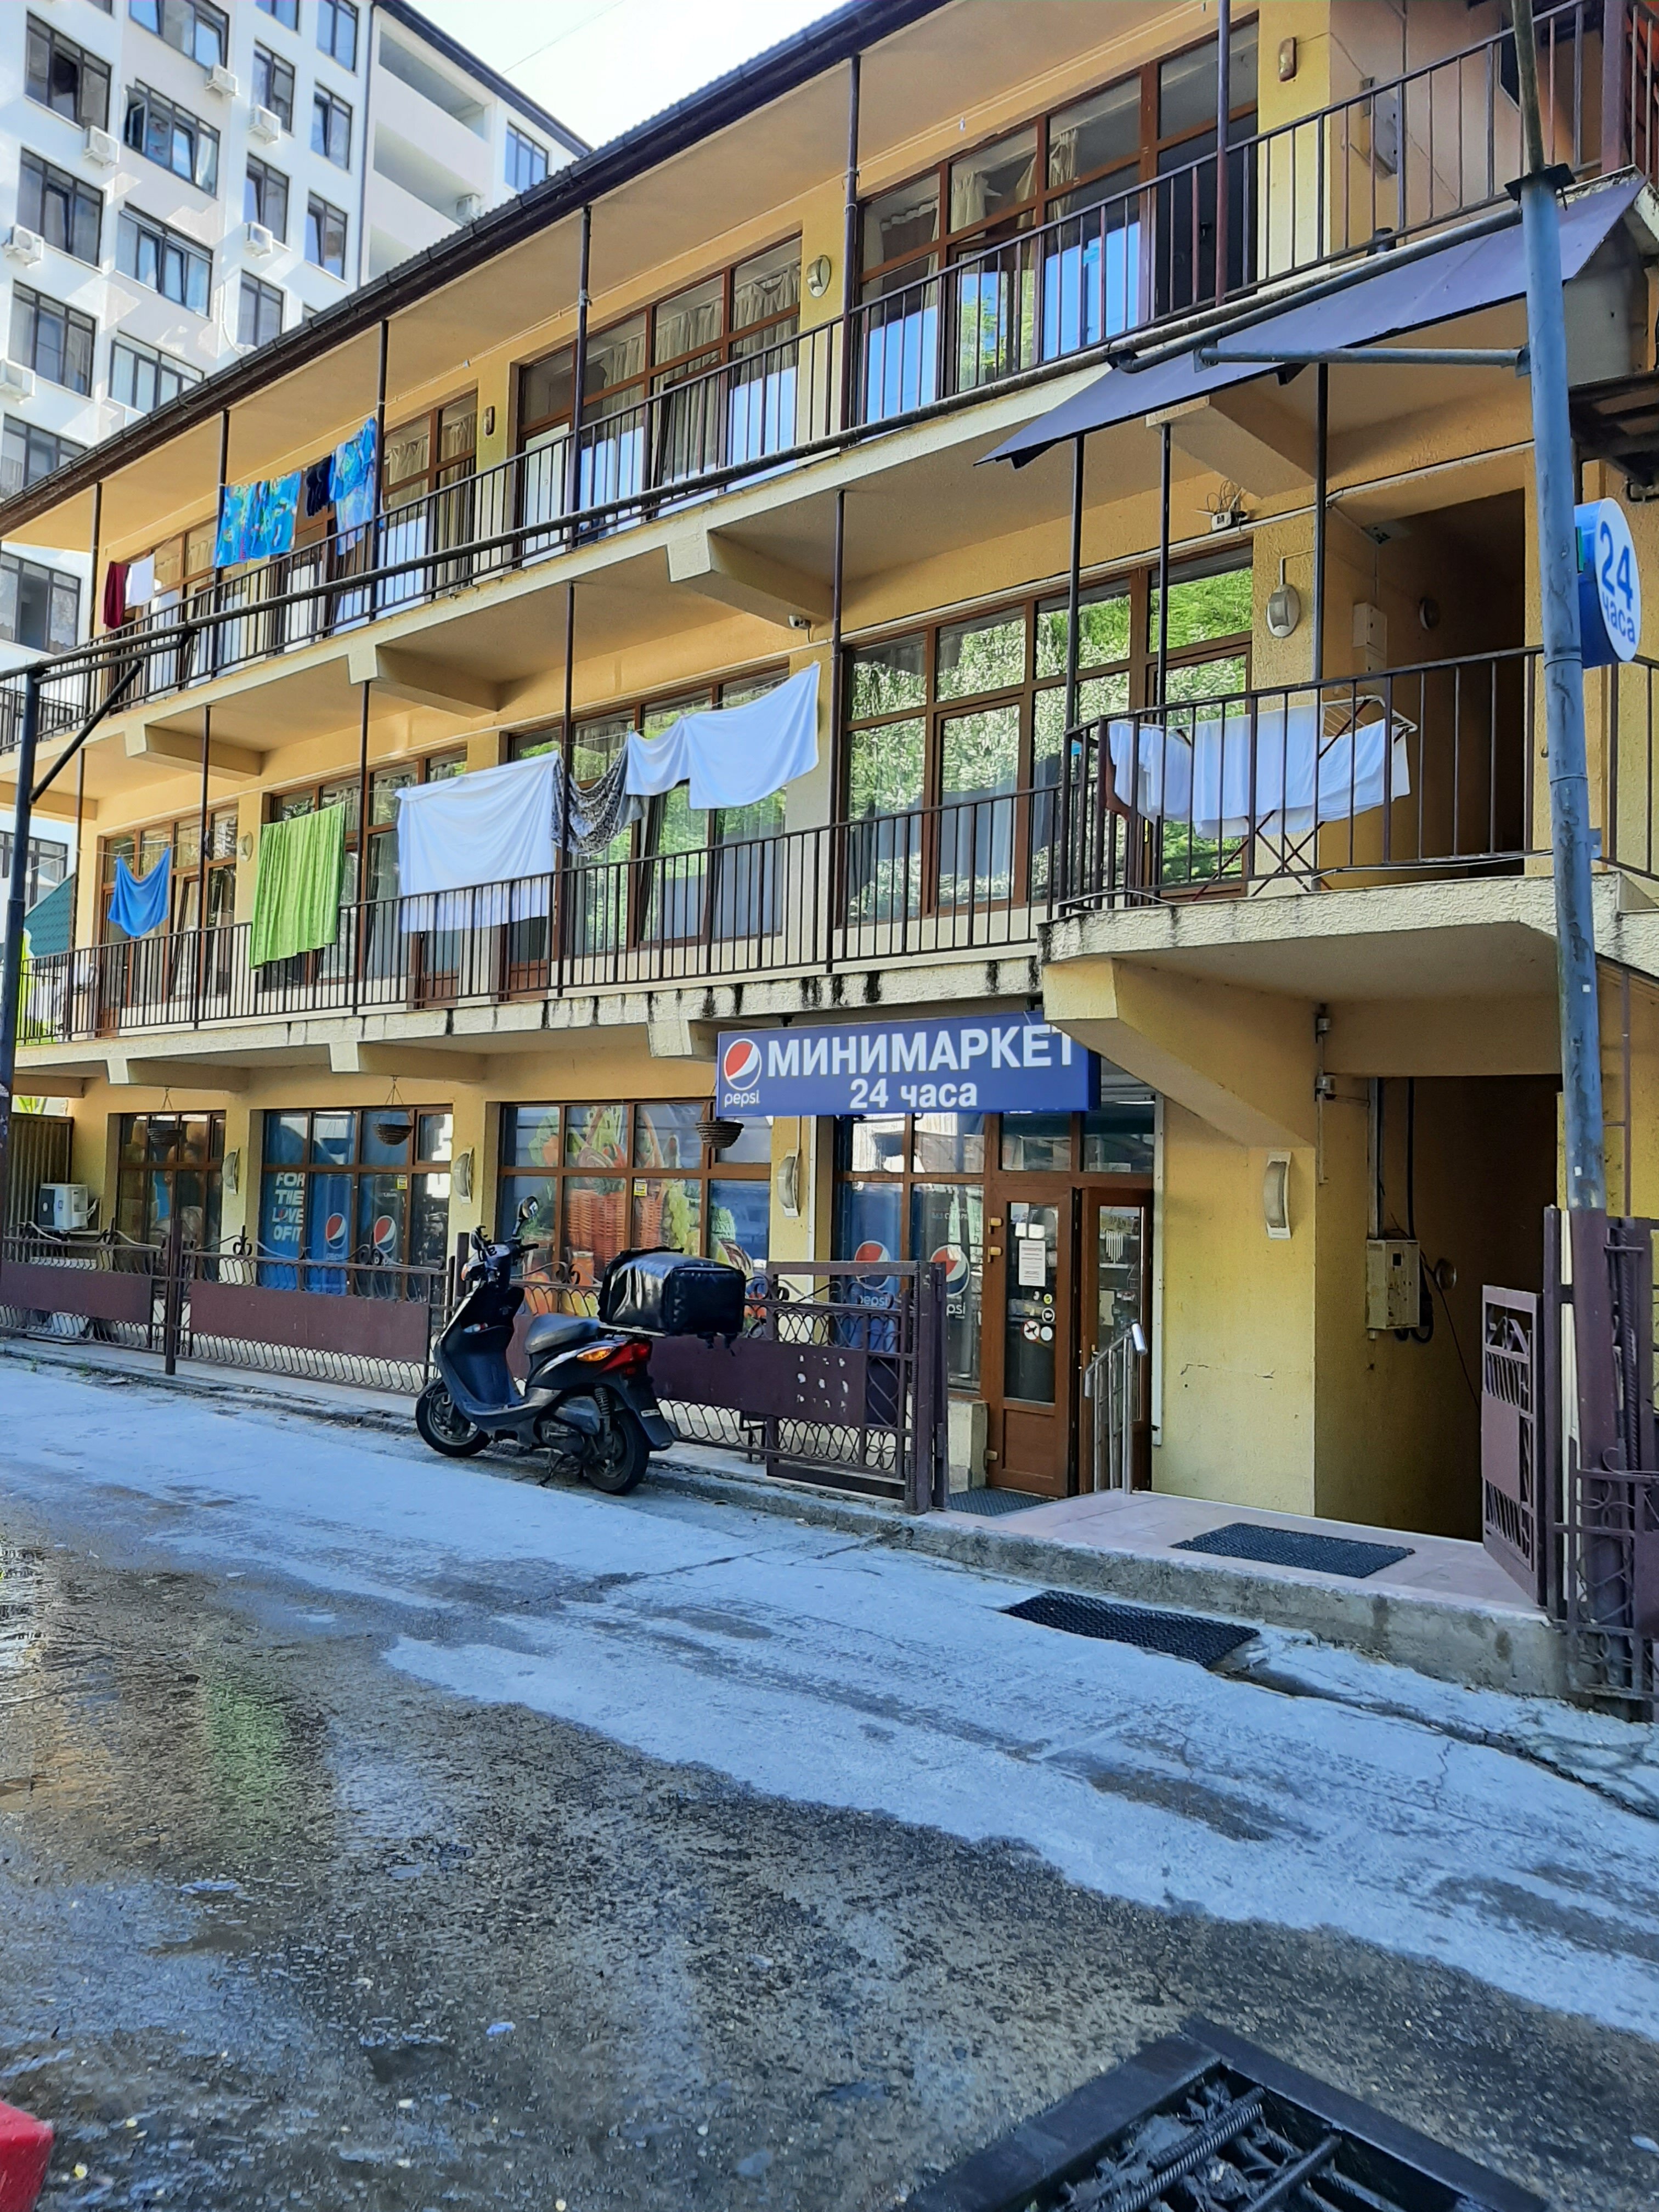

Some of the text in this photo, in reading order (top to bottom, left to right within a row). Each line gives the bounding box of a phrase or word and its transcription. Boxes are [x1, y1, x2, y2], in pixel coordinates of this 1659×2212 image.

[1600, 521, 1633, 612] 24
[1601, 591, 1636, 645] часа
[724, 1090, 760, 1108] pepsi
[850, 1078, 978, 1109] 24 часа
[275, 1189, 304, 1205] THE
